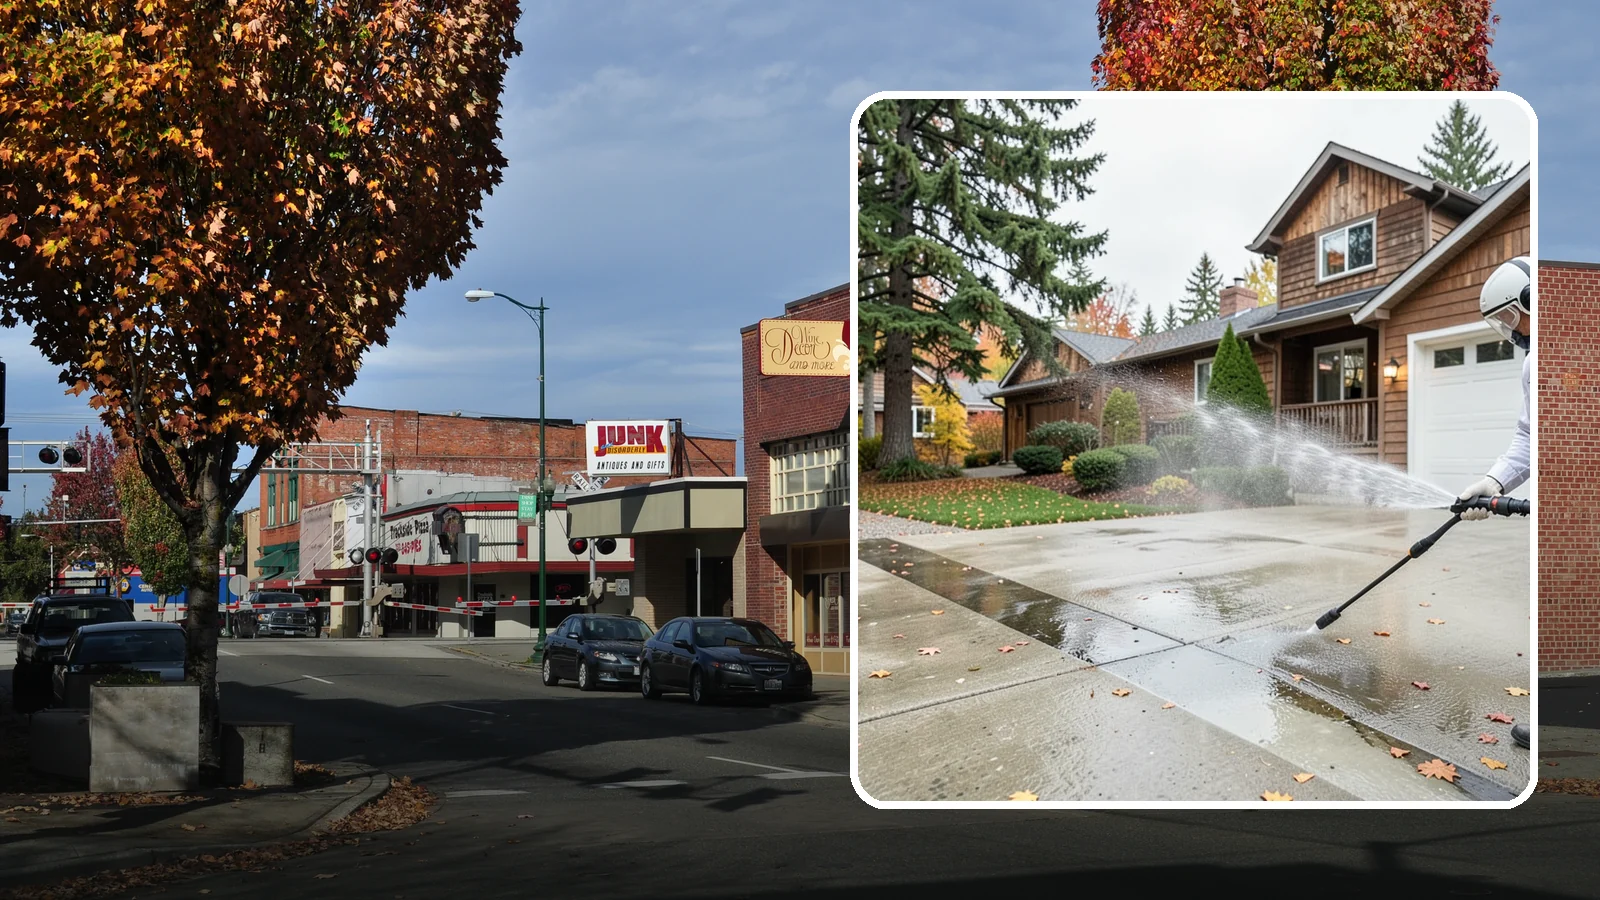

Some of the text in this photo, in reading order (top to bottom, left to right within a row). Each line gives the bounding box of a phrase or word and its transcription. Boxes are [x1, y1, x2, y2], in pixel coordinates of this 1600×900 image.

[595, 425, 665, 457] JUNK
[607, 446, 646, 454] DISORDERLY
[597, 460, 665, 470] ANTIQUES AND GIFTS
[414, 519, 429, 534] Pizza
